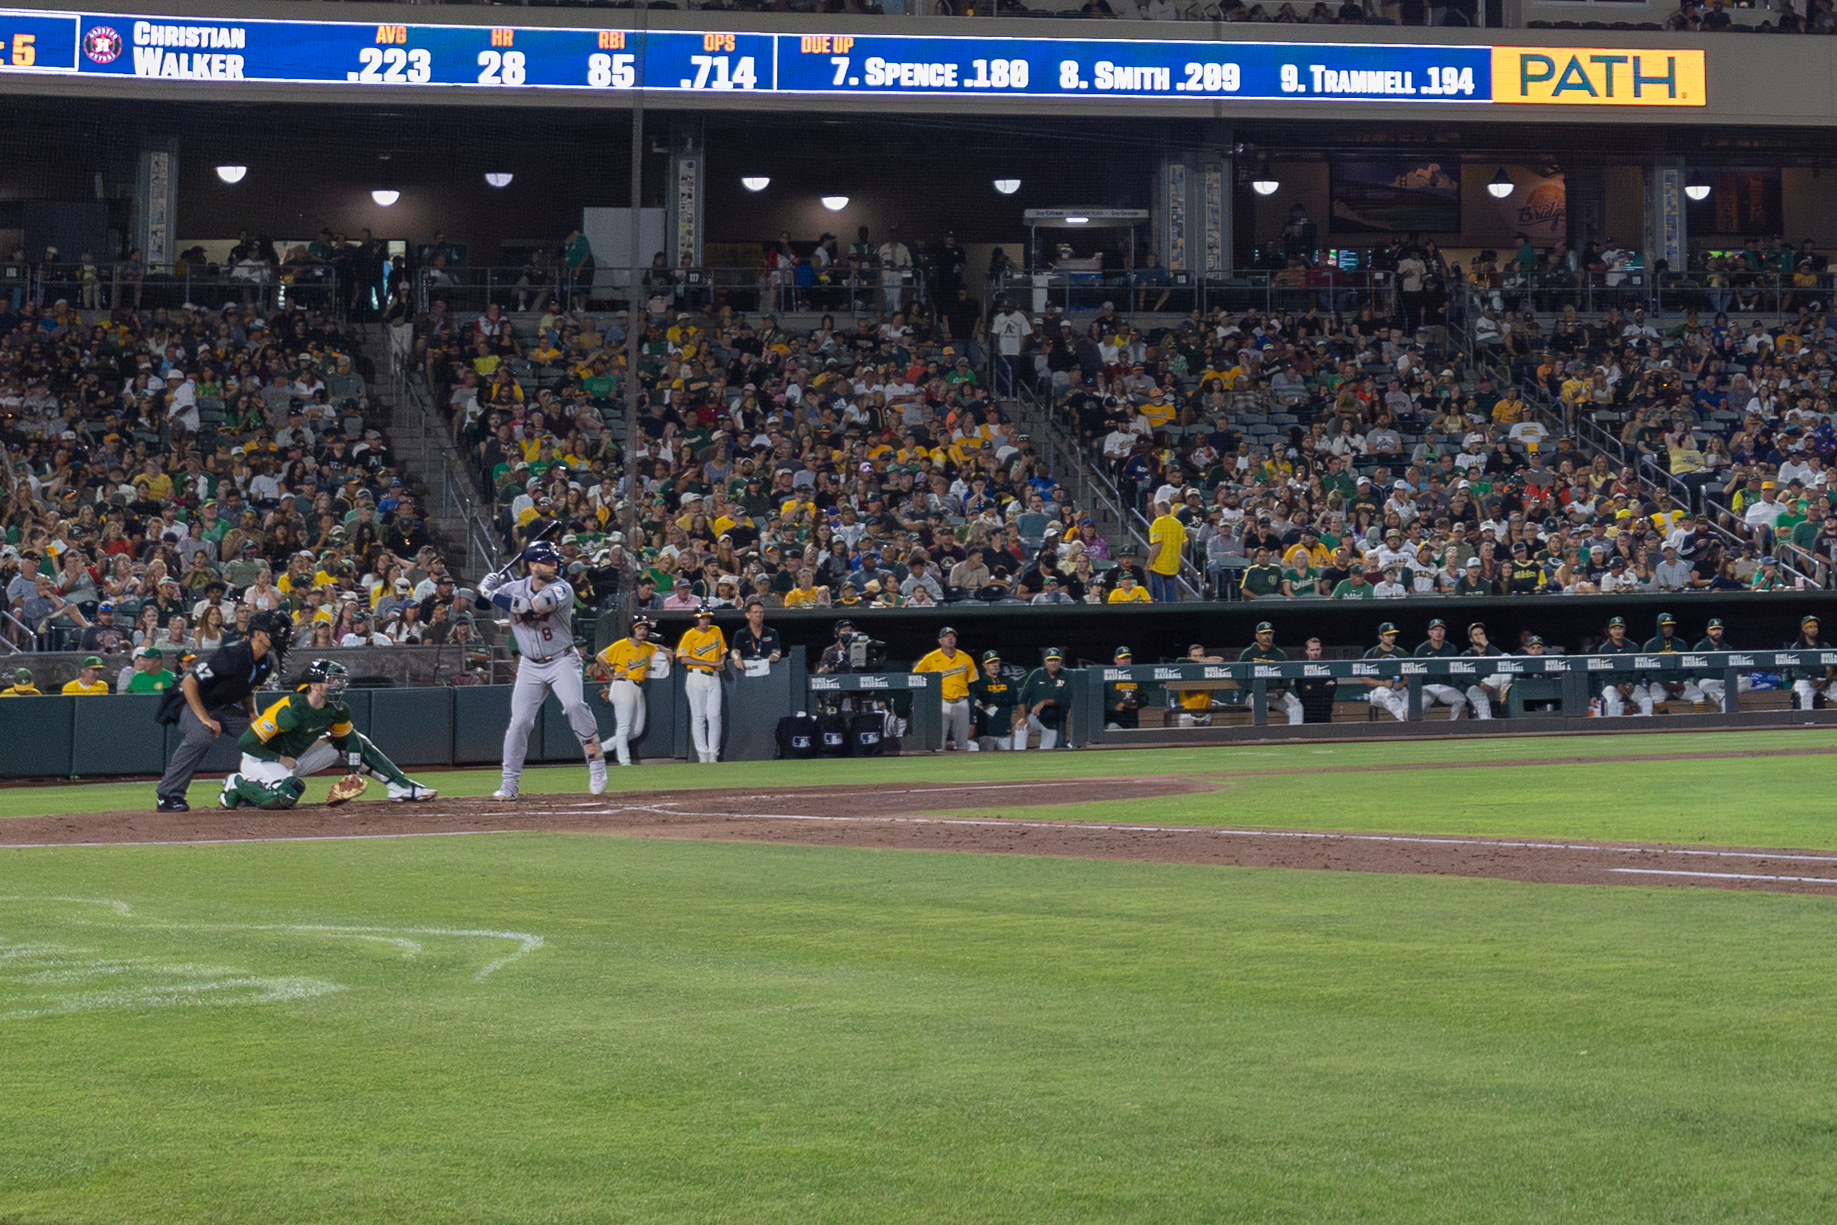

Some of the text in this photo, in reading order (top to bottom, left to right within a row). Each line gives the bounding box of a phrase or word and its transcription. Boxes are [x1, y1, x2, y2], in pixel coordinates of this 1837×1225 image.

[376, 25, 736, 52] AVG HR RBI OPS
[800, 36, 855, 54] DUE UP
[347, 47, 757, 90] .223 28 85 .714
[830, 57, 859, 86] 7.
[1059, 60, 1089, 89] 8.
[1280, 64, 1305, 93] 9.
[1420, 67, 1475, 95] .194
[1519, 53, 1677, 99] PATH
[541, 626, 553, 641] 8
